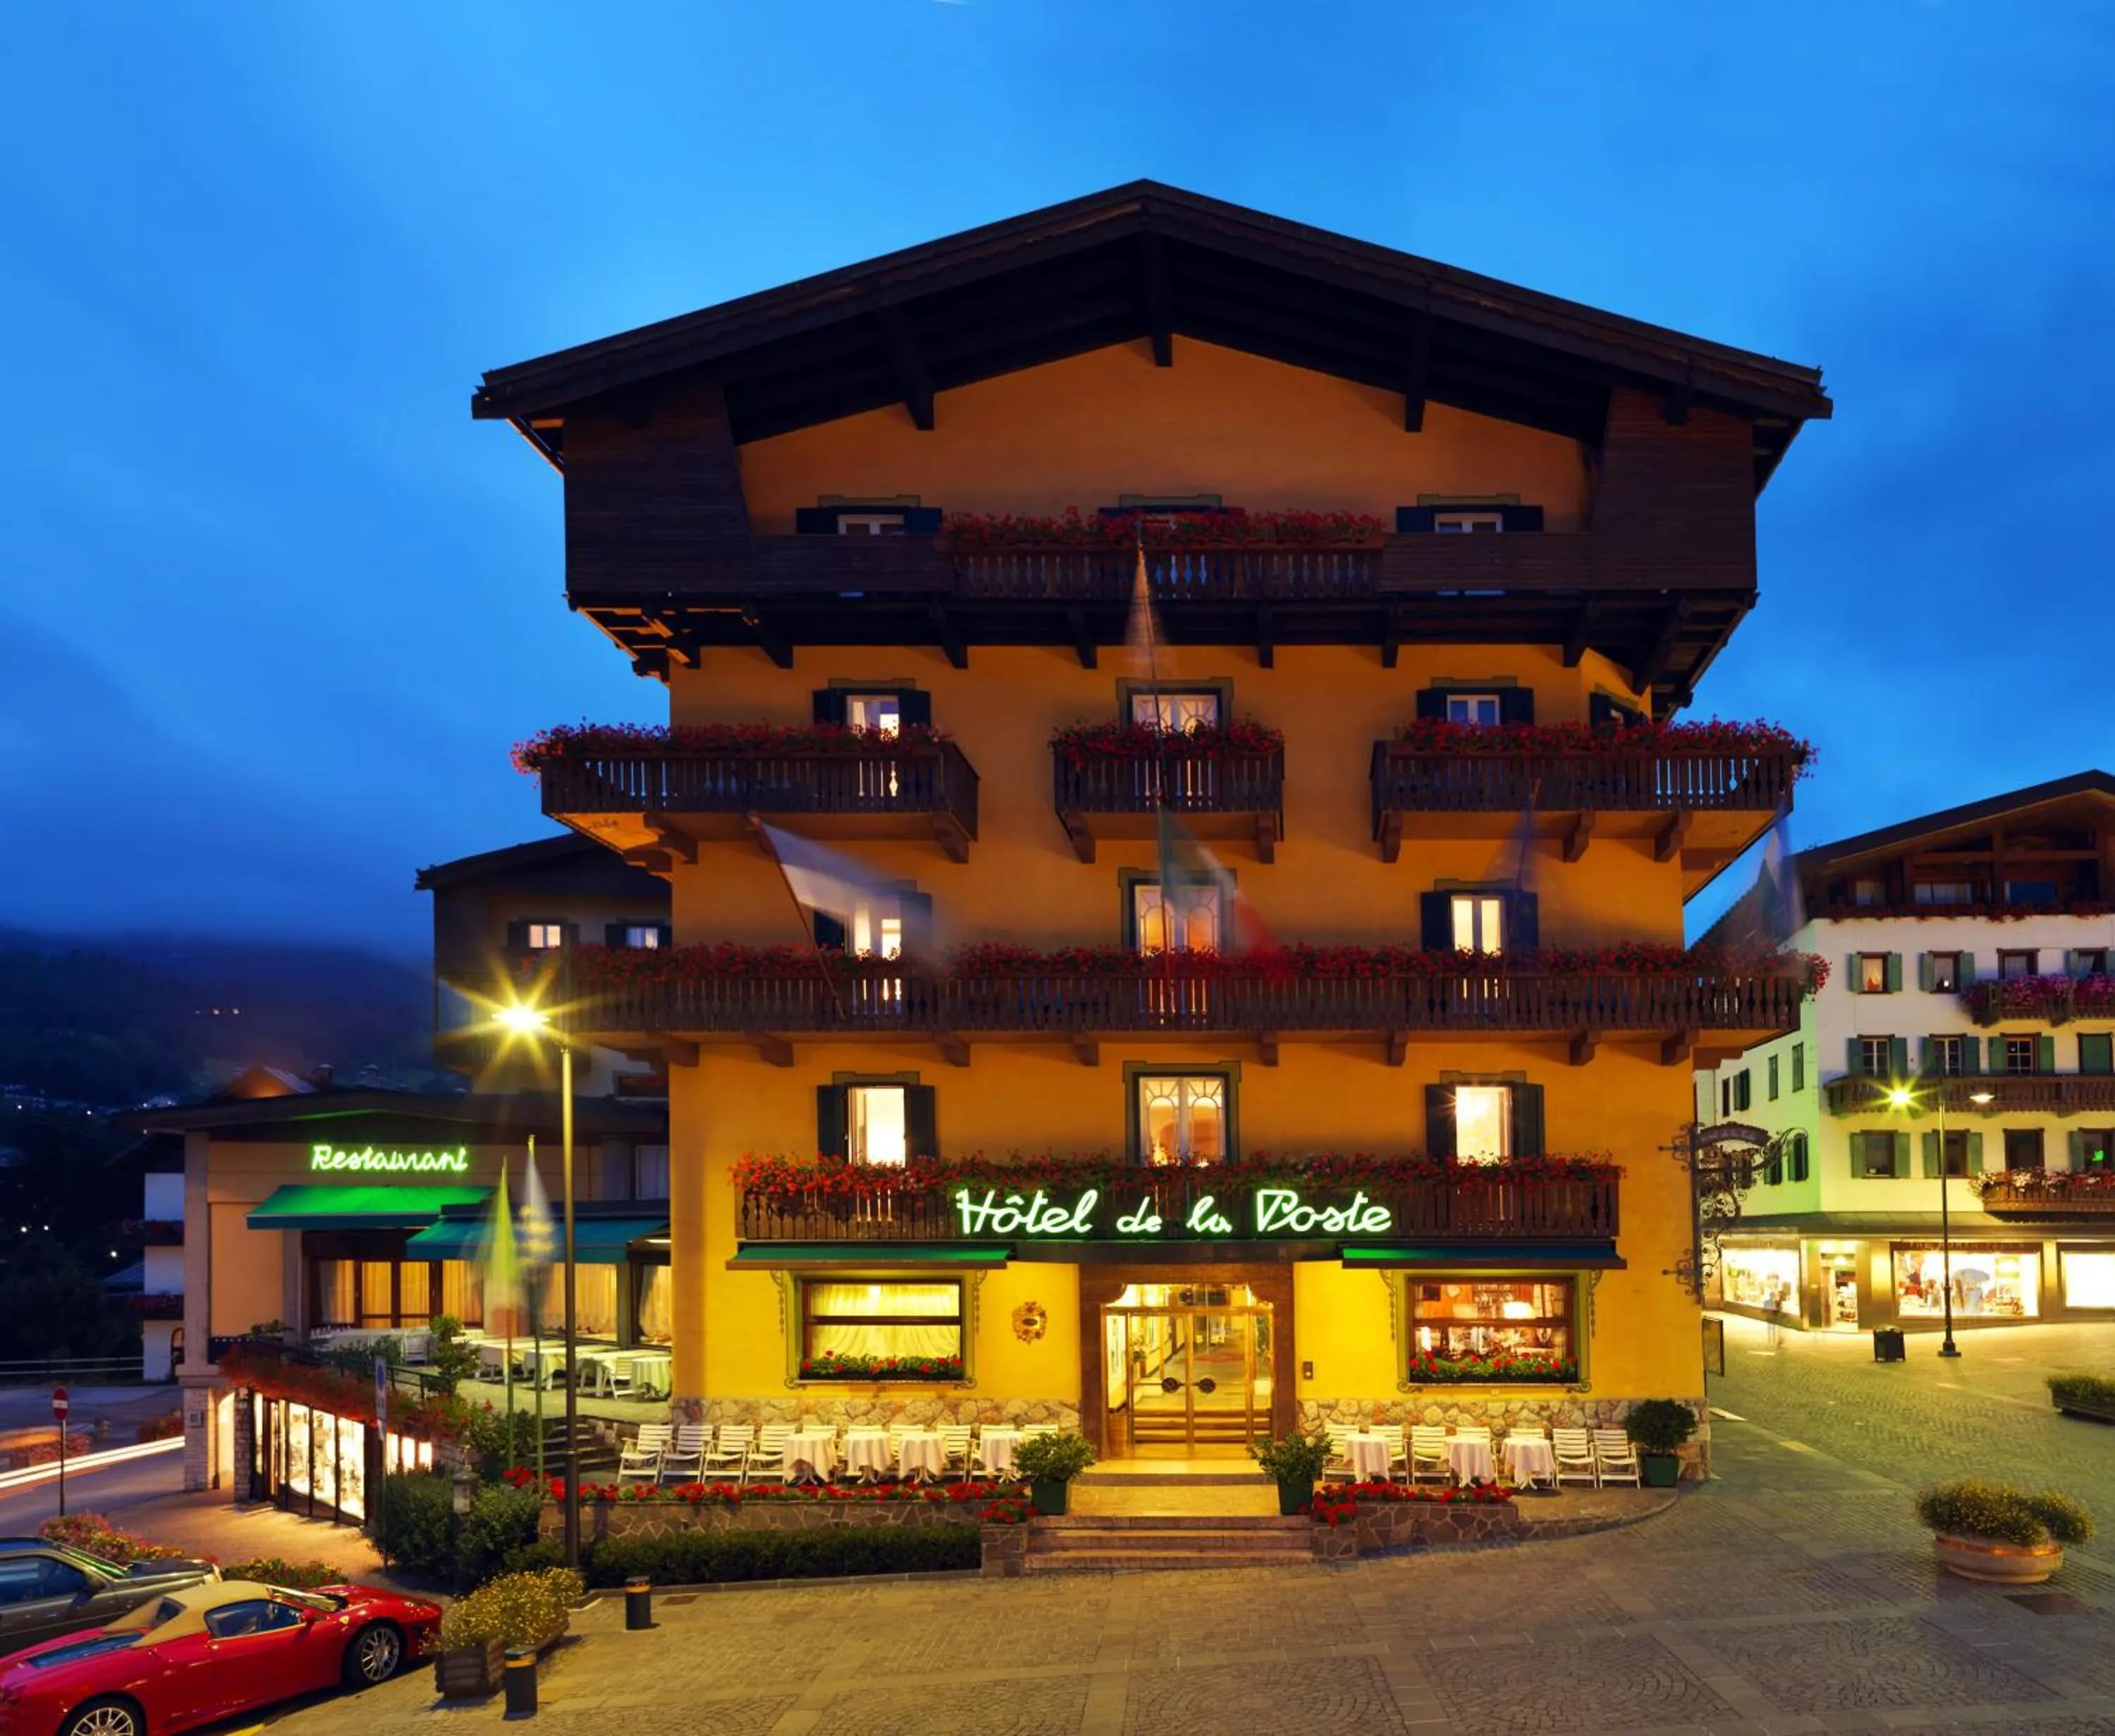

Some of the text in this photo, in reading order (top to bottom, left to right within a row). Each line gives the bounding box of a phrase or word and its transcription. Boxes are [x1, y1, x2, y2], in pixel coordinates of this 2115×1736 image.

[312, 1144, 468, 1171] Restaurant
[955, 1189, 1392, 1234] Hôtel de la Poste
